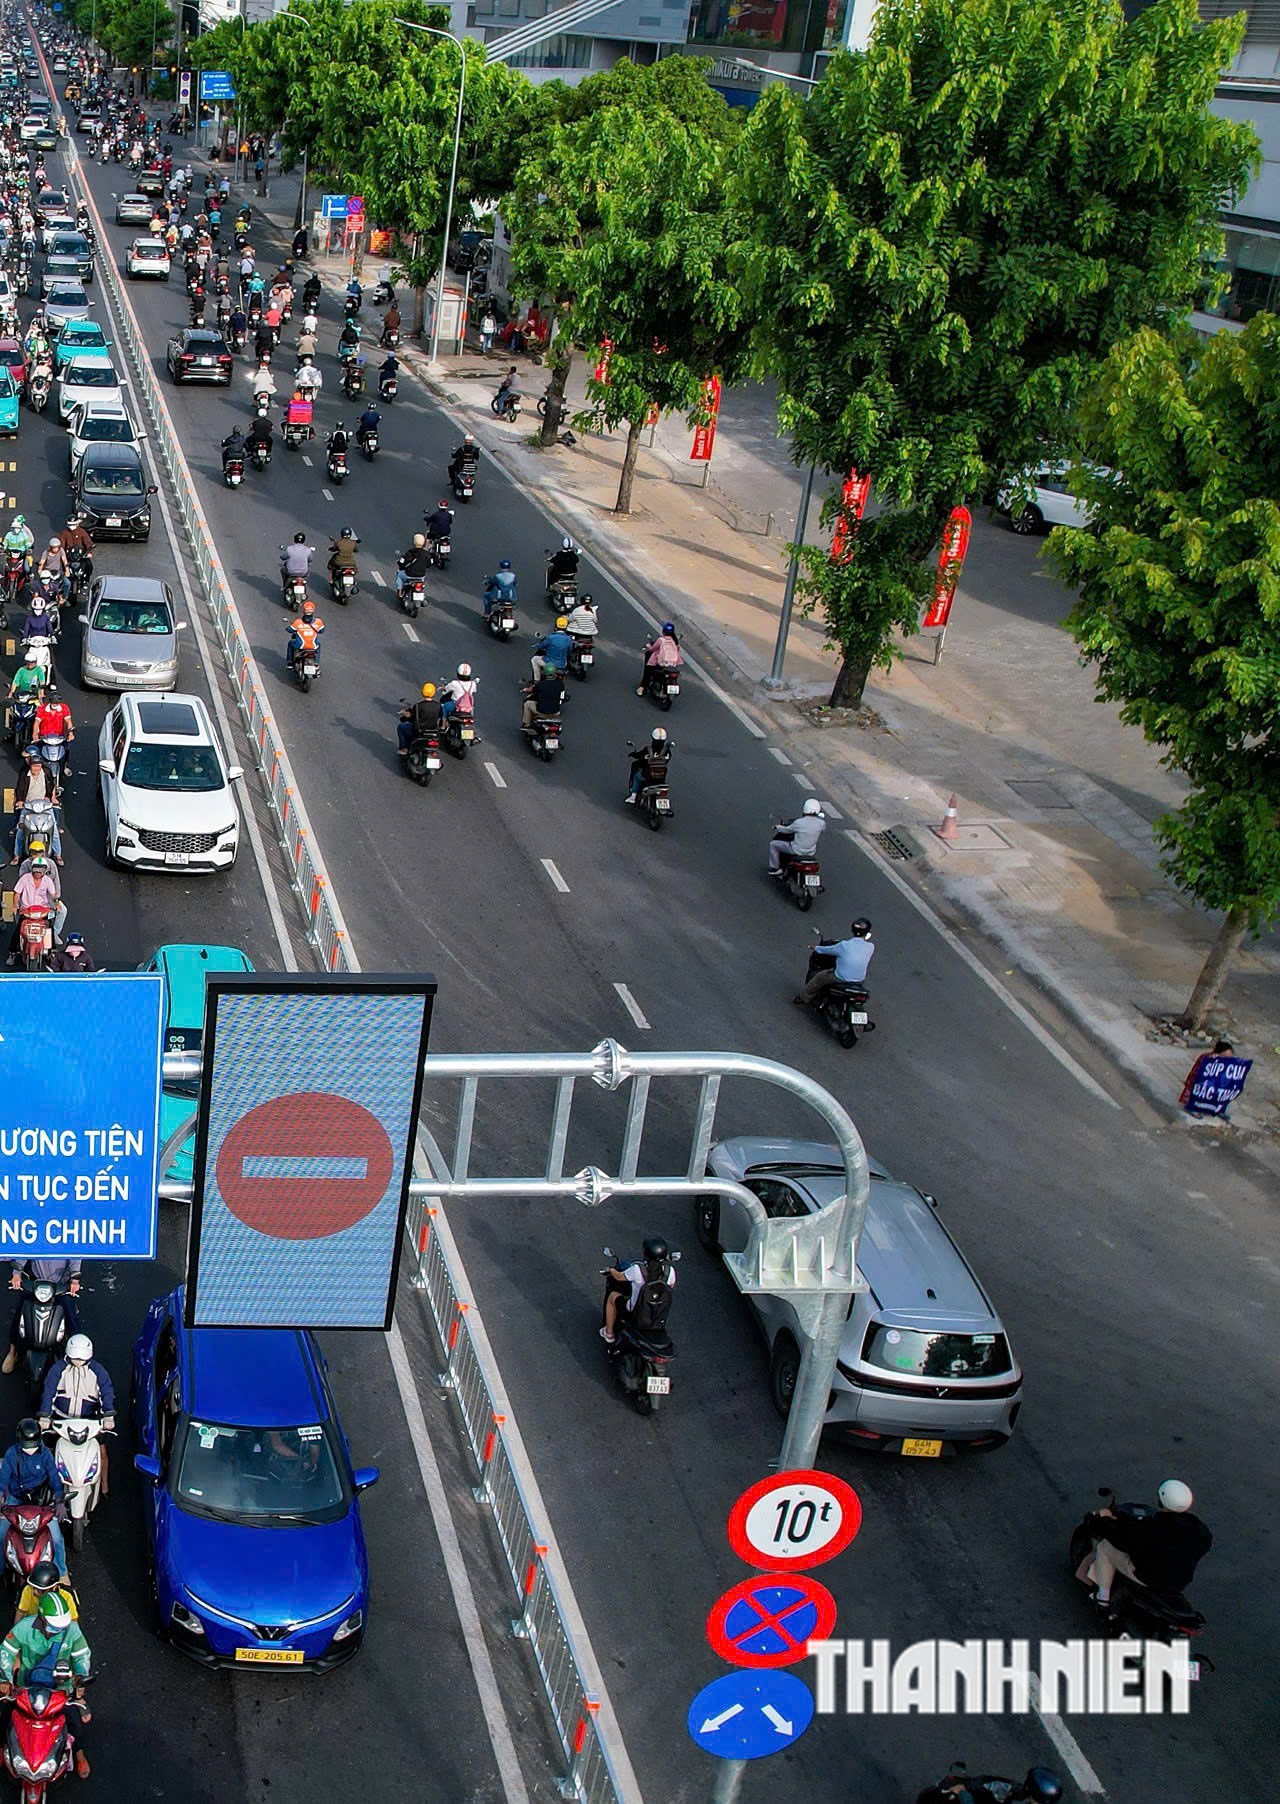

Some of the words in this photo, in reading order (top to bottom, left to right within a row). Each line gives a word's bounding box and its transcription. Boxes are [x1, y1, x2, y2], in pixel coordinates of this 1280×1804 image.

[1203, 1059, 1224, 1077] SÚP
[84, 1124, 144, 1162] TIỆN
[17, 1175, 68, 1207] TỤC
[74, 1165, 129, 1201] ĐẾN
[45, 1218, 126, 1244] CHINH
[241, 1651, 298, 1662] 50E-205.61
